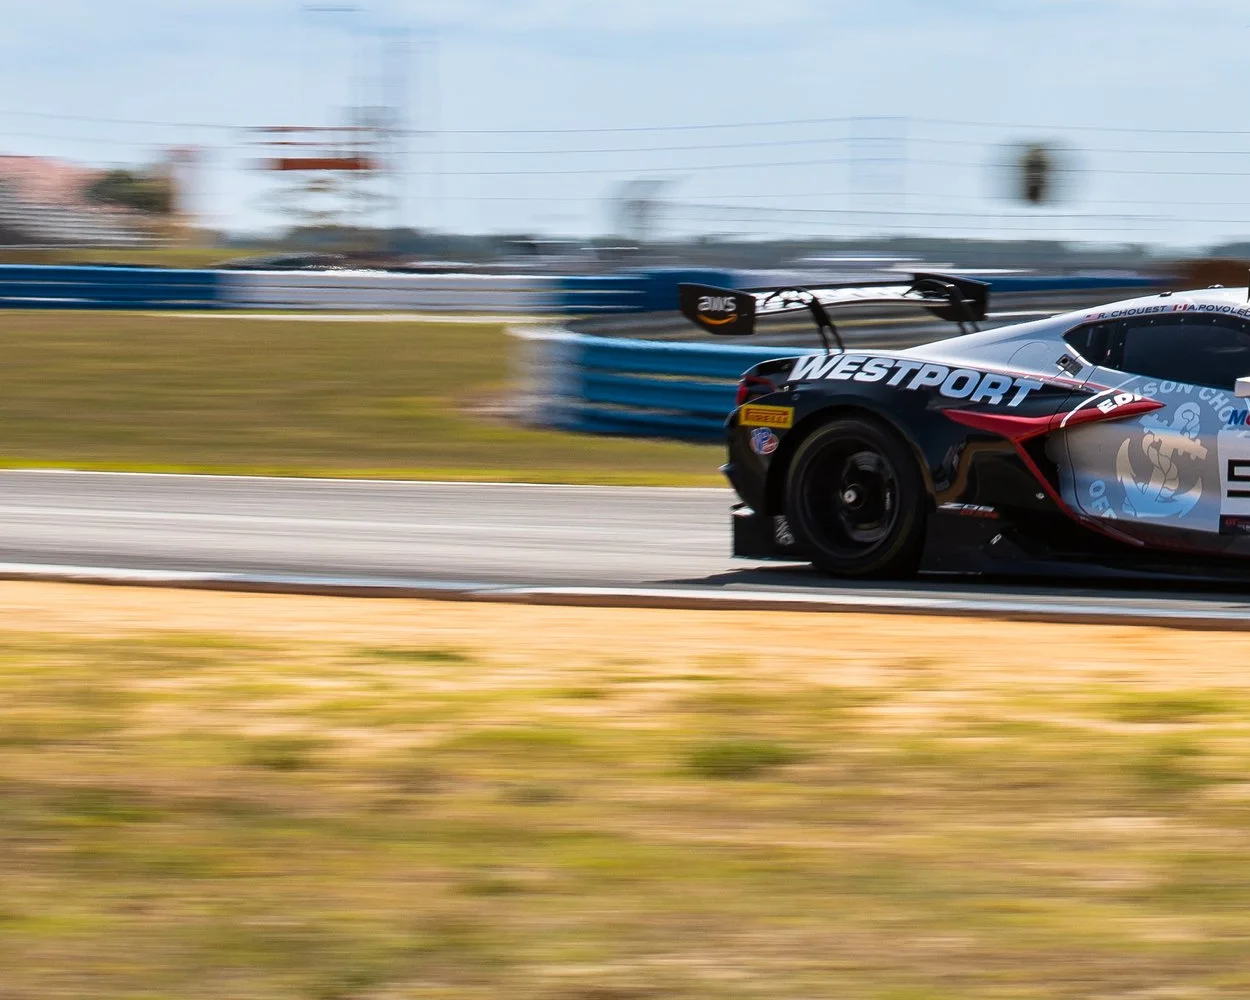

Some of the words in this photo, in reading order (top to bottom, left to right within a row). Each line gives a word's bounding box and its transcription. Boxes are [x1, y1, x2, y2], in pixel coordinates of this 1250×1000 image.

[697, 296, 736, 312] aws
[1097, 312, 1108, 320] R.
[1111, 305, 1168, 318] CHOUEST
[789, 356, 1044, 407] WESTPORT
[1097, 380, 1195, 415] EDISON
[744, 408, 789, 424] PIRELLI
